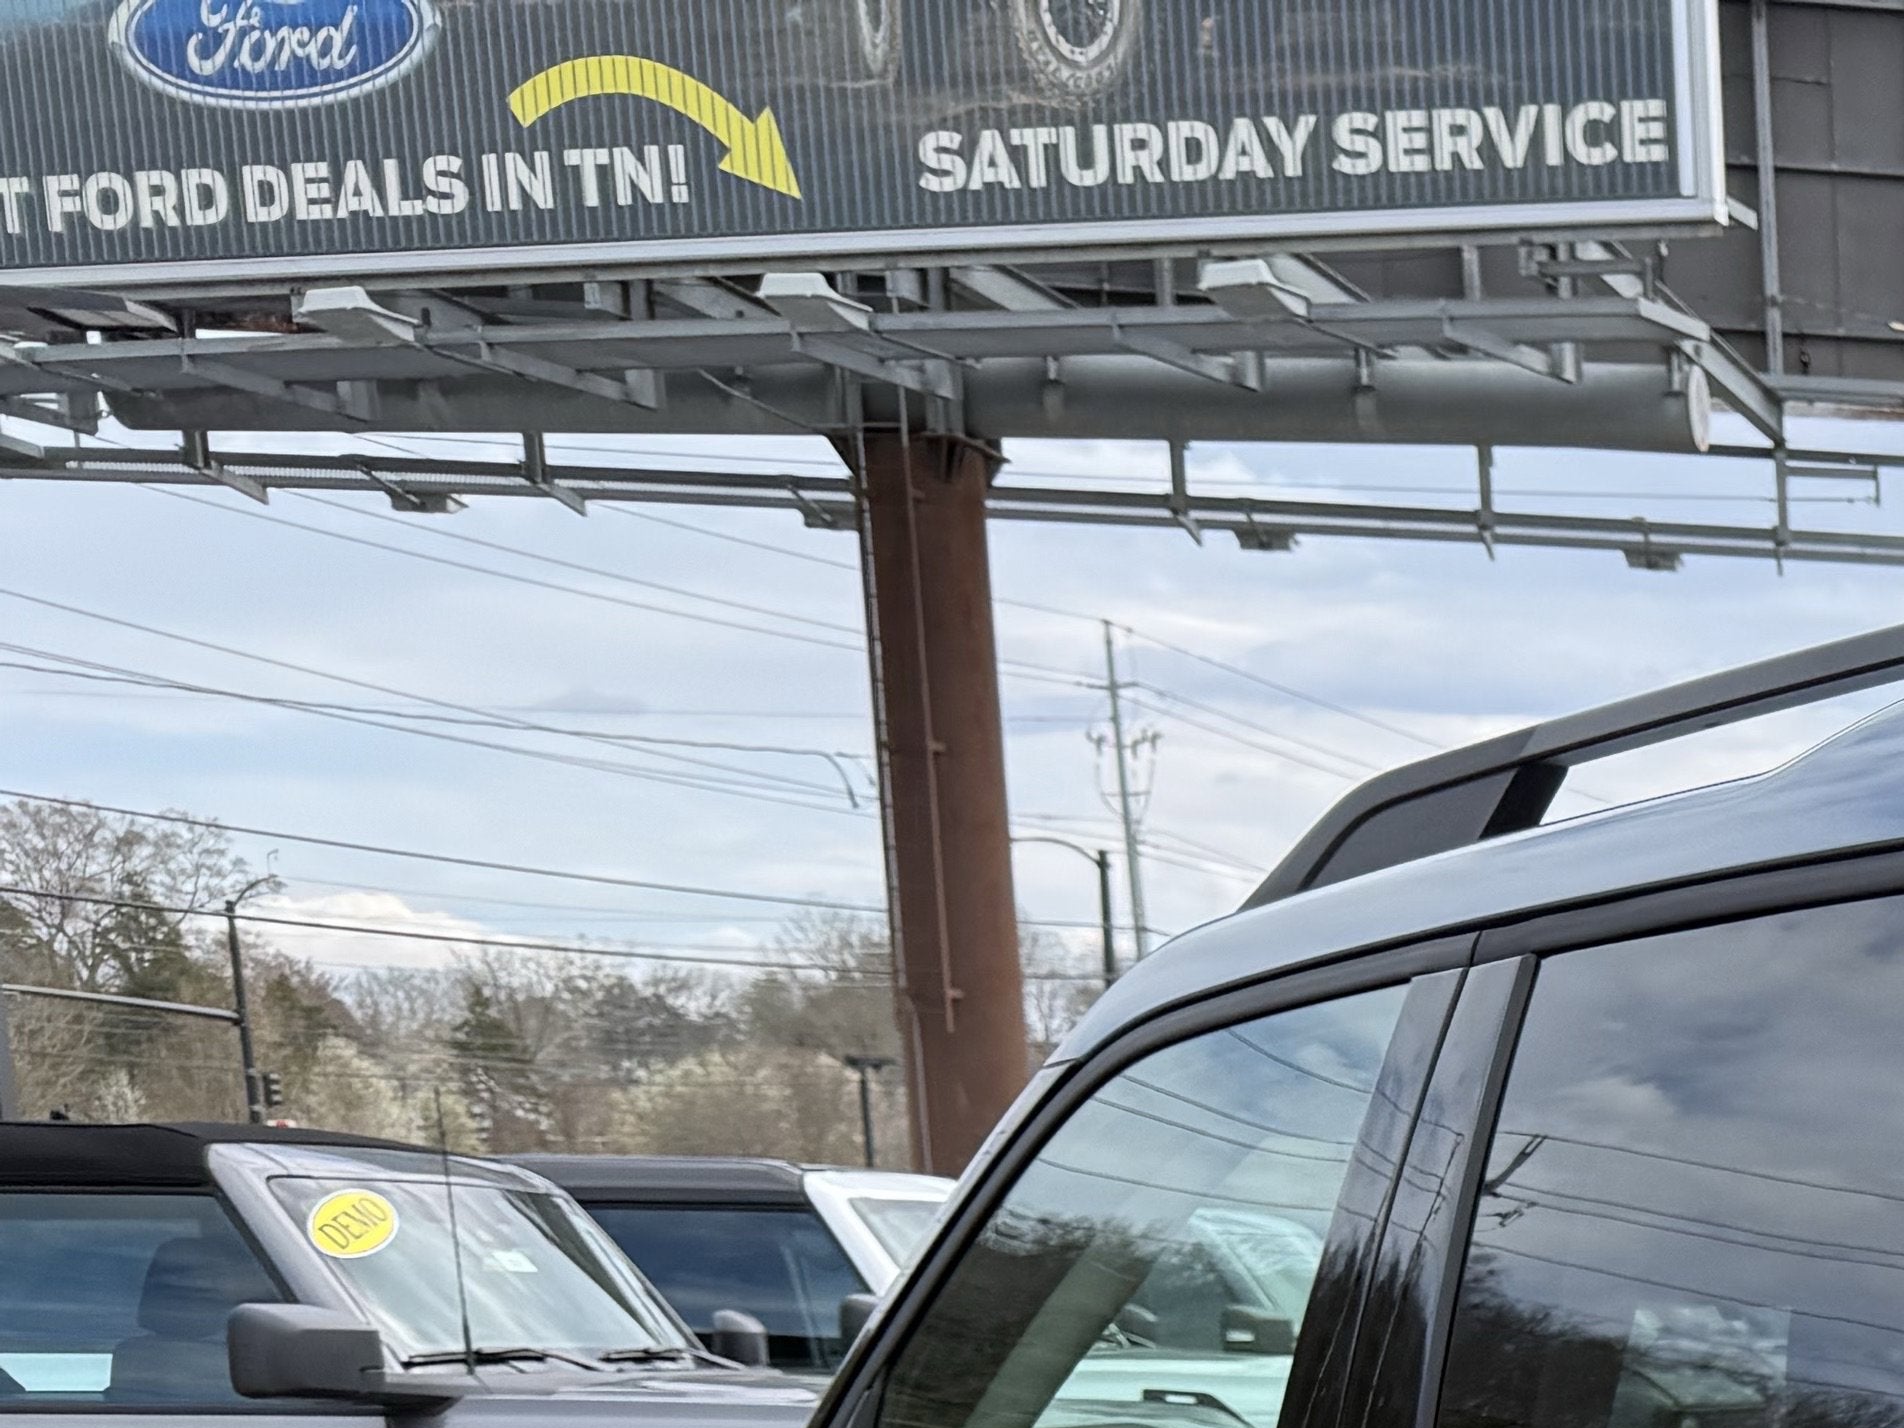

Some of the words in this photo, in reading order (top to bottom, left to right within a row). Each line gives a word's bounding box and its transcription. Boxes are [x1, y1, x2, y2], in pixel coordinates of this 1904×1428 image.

[186, 0, 360, 75] Ford
[917, 113, 1317, 193] SATURDAY
[1330, 98, 1670, 176] SERVICE
[44, 166, 228, 234] FORD
[242, 153, 471, 224] DEALS
[481, 149, 556, 213] IN
[563, 143, 690, 206] TN!
[317, 1196, 389, 1251] DEMO
